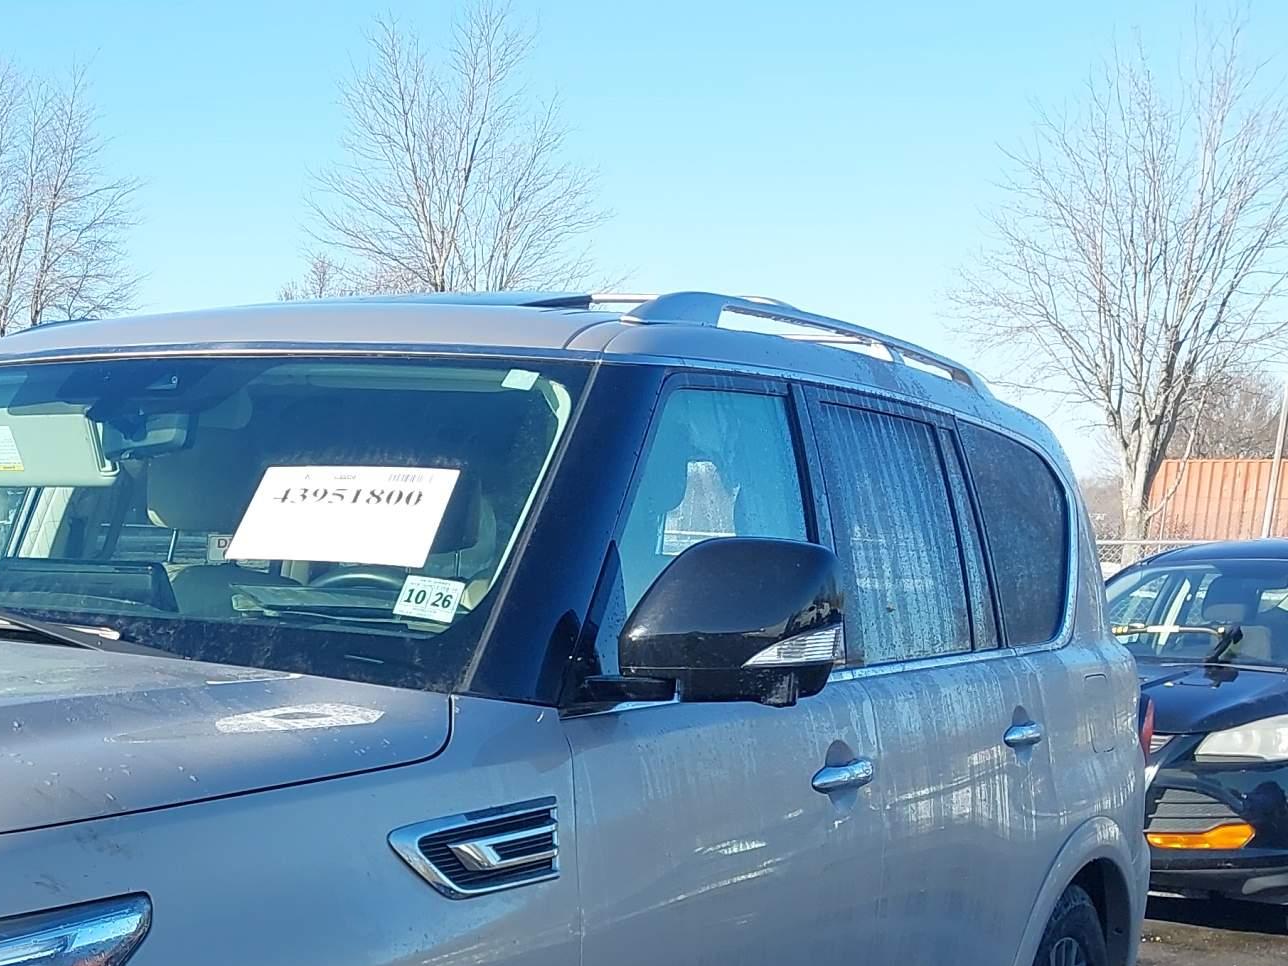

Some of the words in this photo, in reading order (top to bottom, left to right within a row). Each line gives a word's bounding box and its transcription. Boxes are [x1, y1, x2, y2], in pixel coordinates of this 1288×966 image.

[273, 487, 423, 506] 43951800
[404, 588, 427, 604] 10
[430, 592, 453, 608] 26
